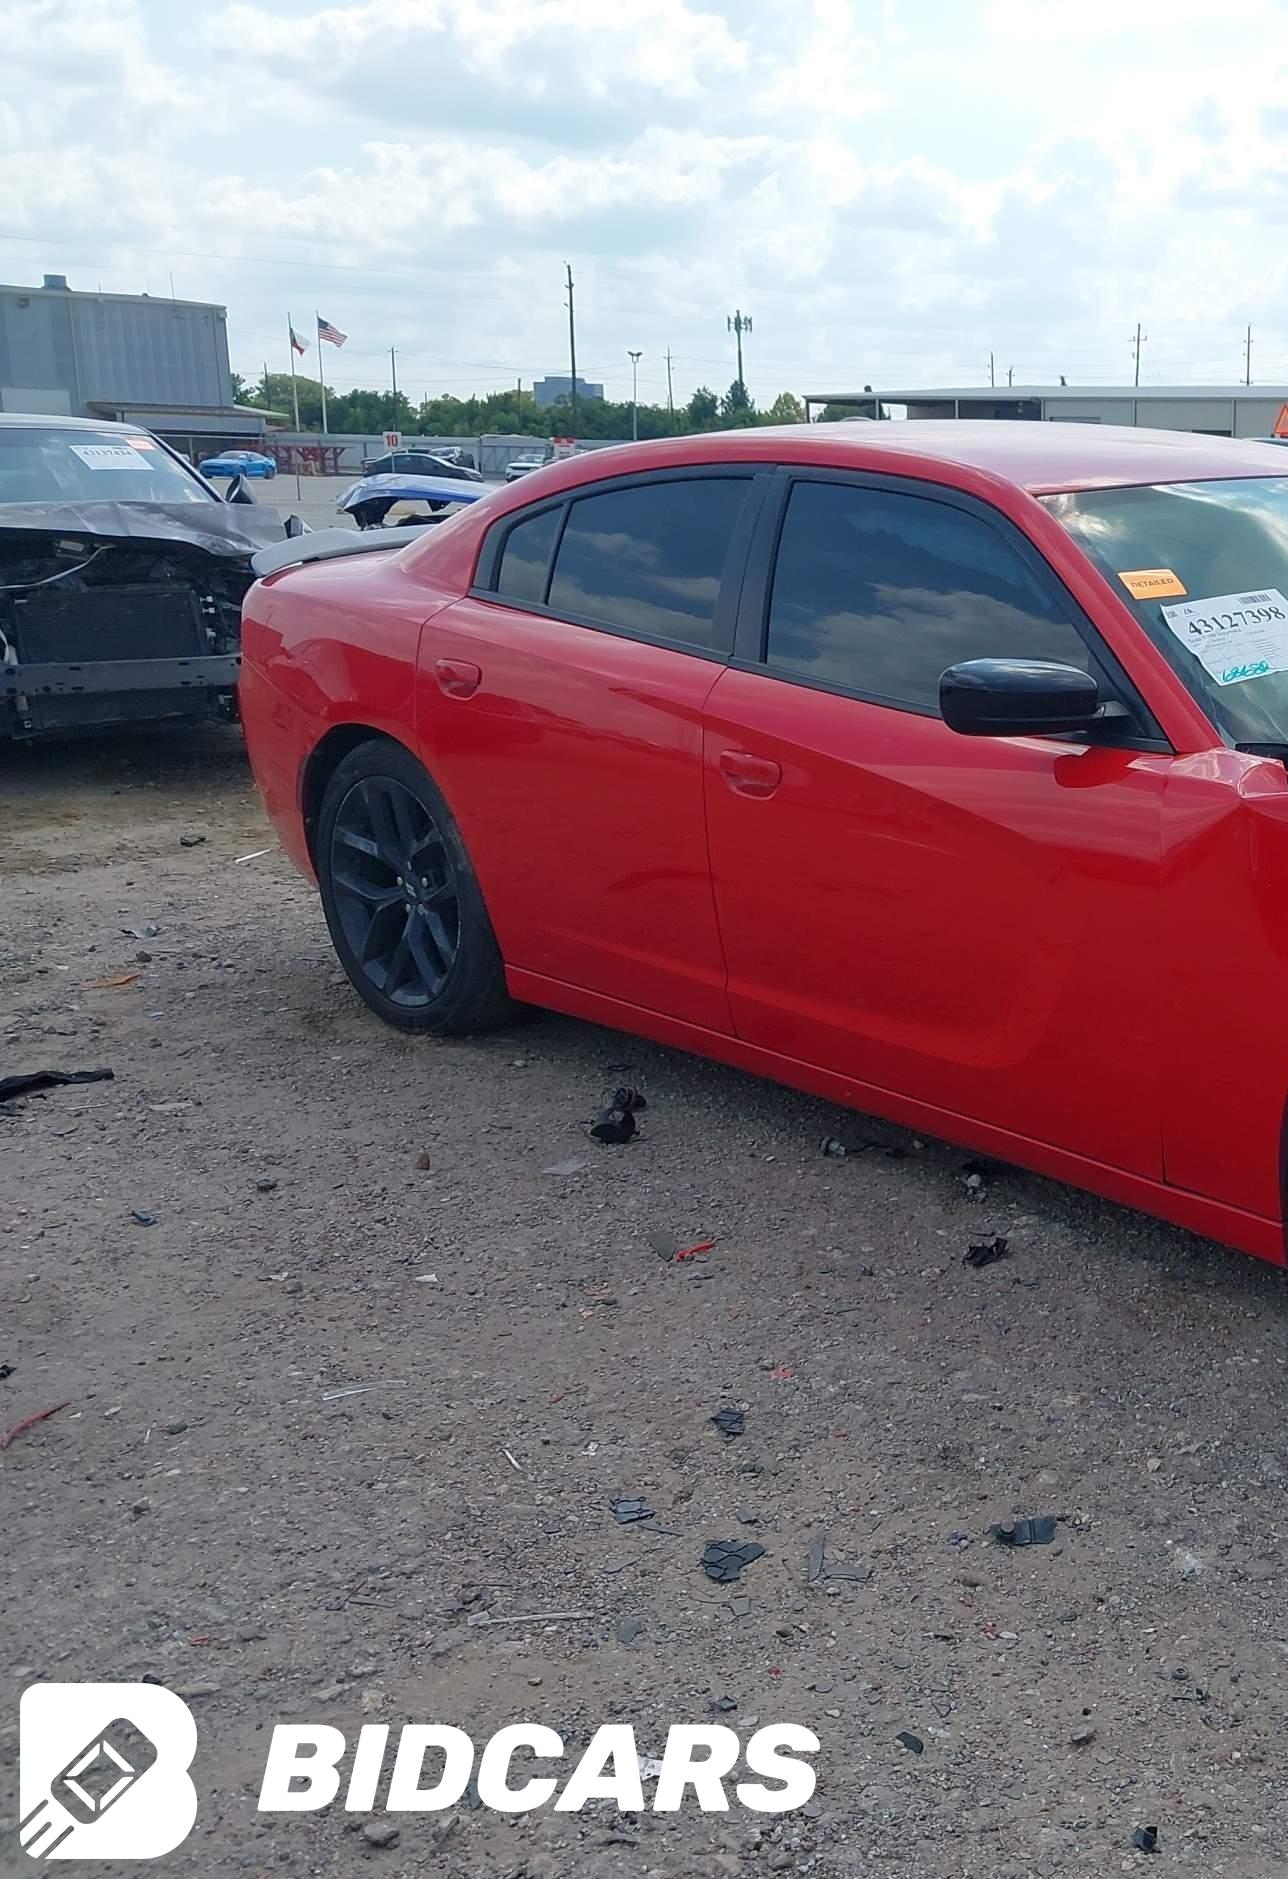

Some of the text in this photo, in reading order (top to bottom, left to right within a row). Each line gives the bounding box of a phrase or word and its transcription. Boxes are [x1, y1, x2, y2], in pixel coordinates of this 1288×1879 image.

[385, 434, 398, 447] 10
[1130, 578, 1174, 588] DETAILED
[1188, 606, 1286, 634] 43127398
